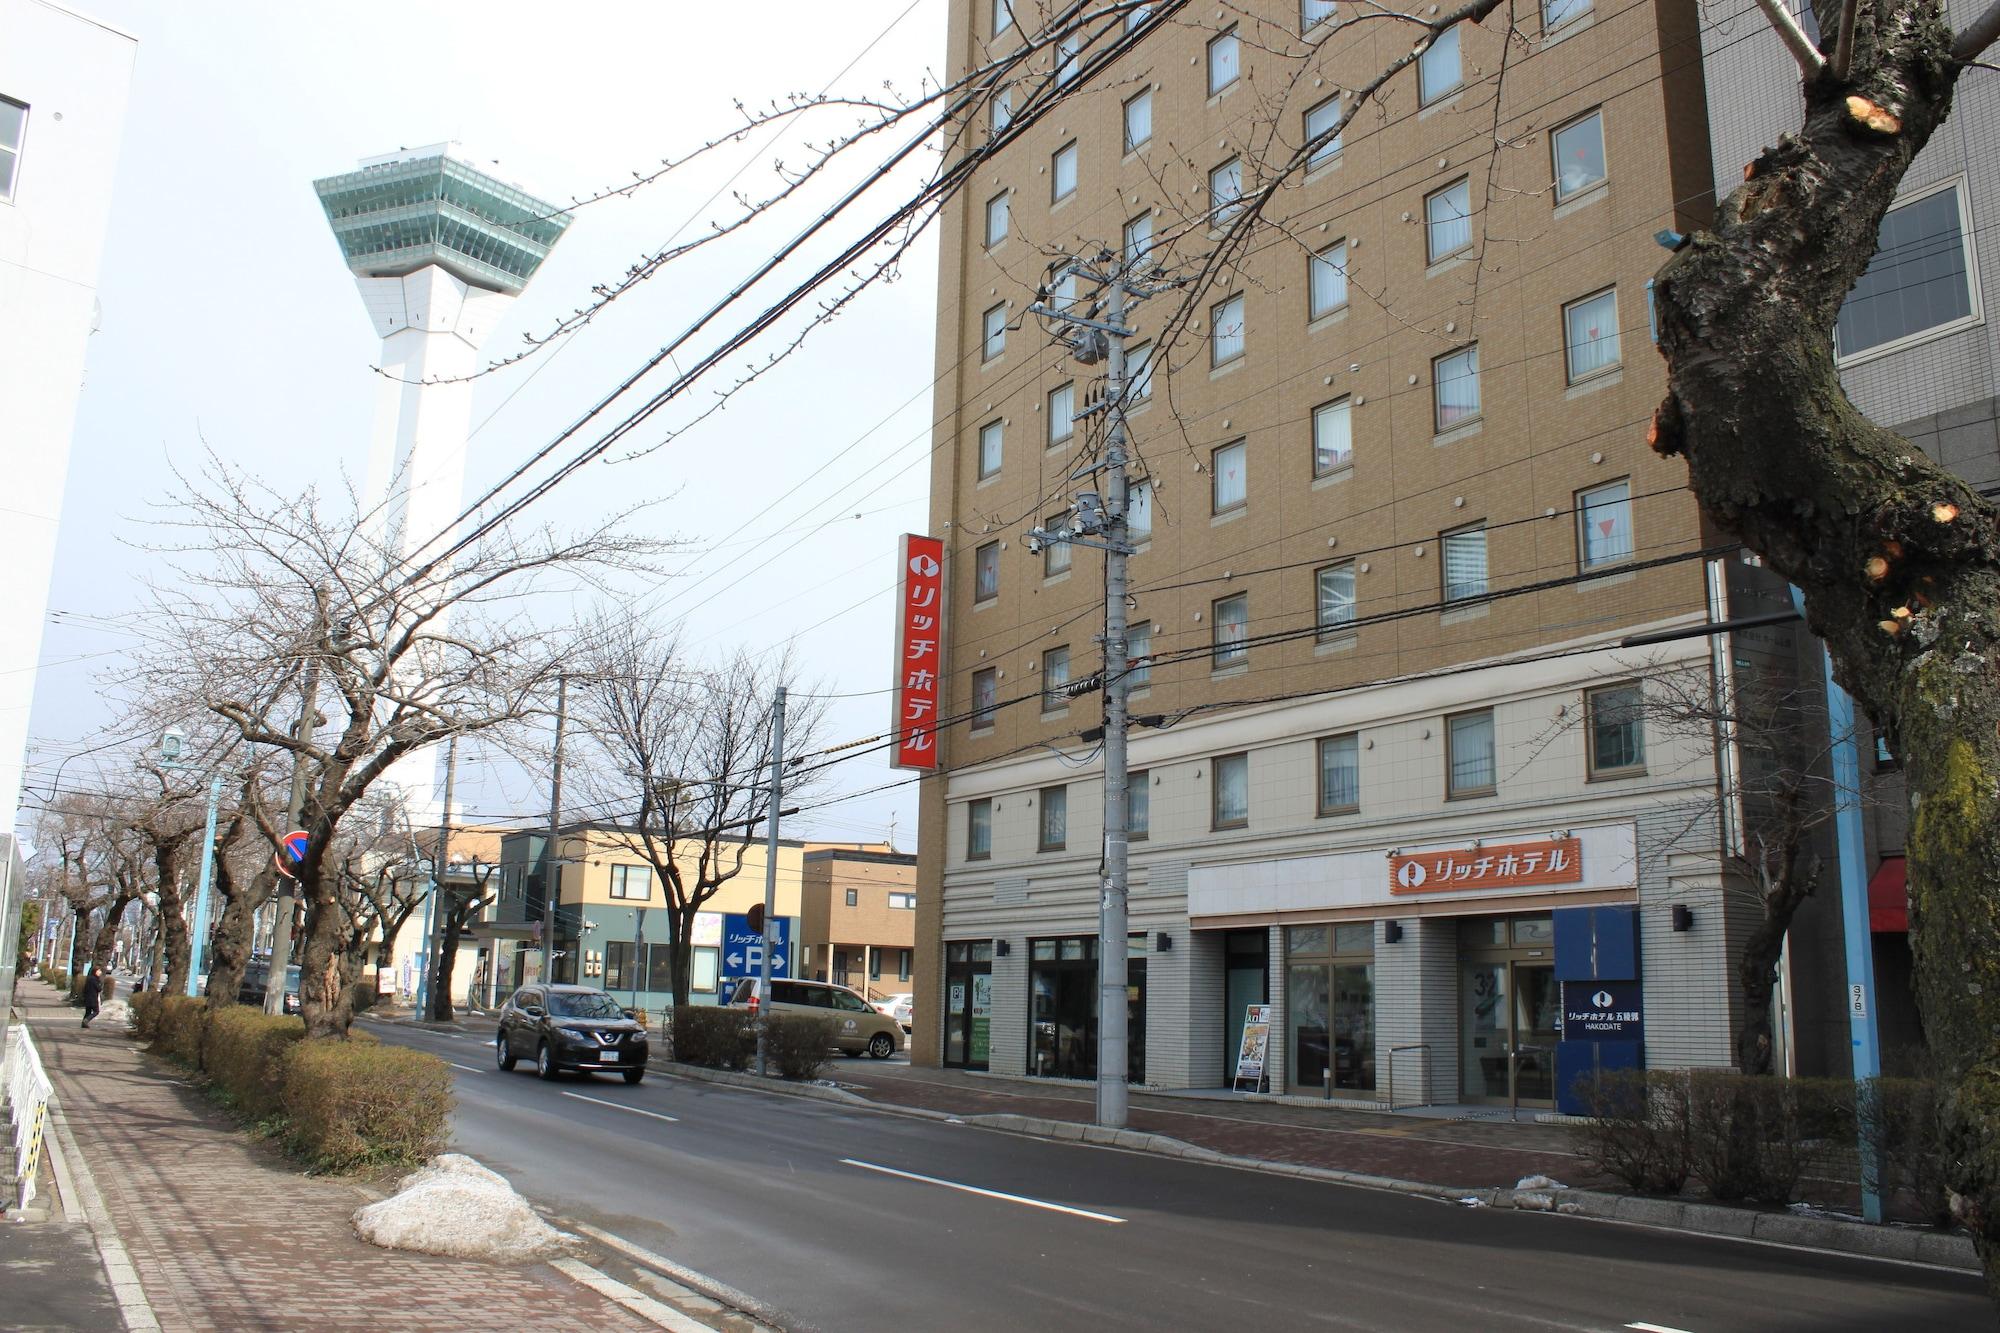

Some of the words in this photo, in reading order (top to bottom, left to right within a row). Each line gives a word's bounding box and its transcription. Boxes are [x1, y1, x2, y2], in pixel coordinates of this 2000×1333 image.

[904, 585, 935, 751] リッチホテル
[1435, 849, 1570, 882] リッチホテル
[729, 934, 784, 945] リッチホル
[745, 946, 763, 973] P
[1853, 985, 1861, 1010] 378
[1568, 1012, 1614, 1021] リッチホテル
[1585, 1022, 1622, 1030] HAKODATE
